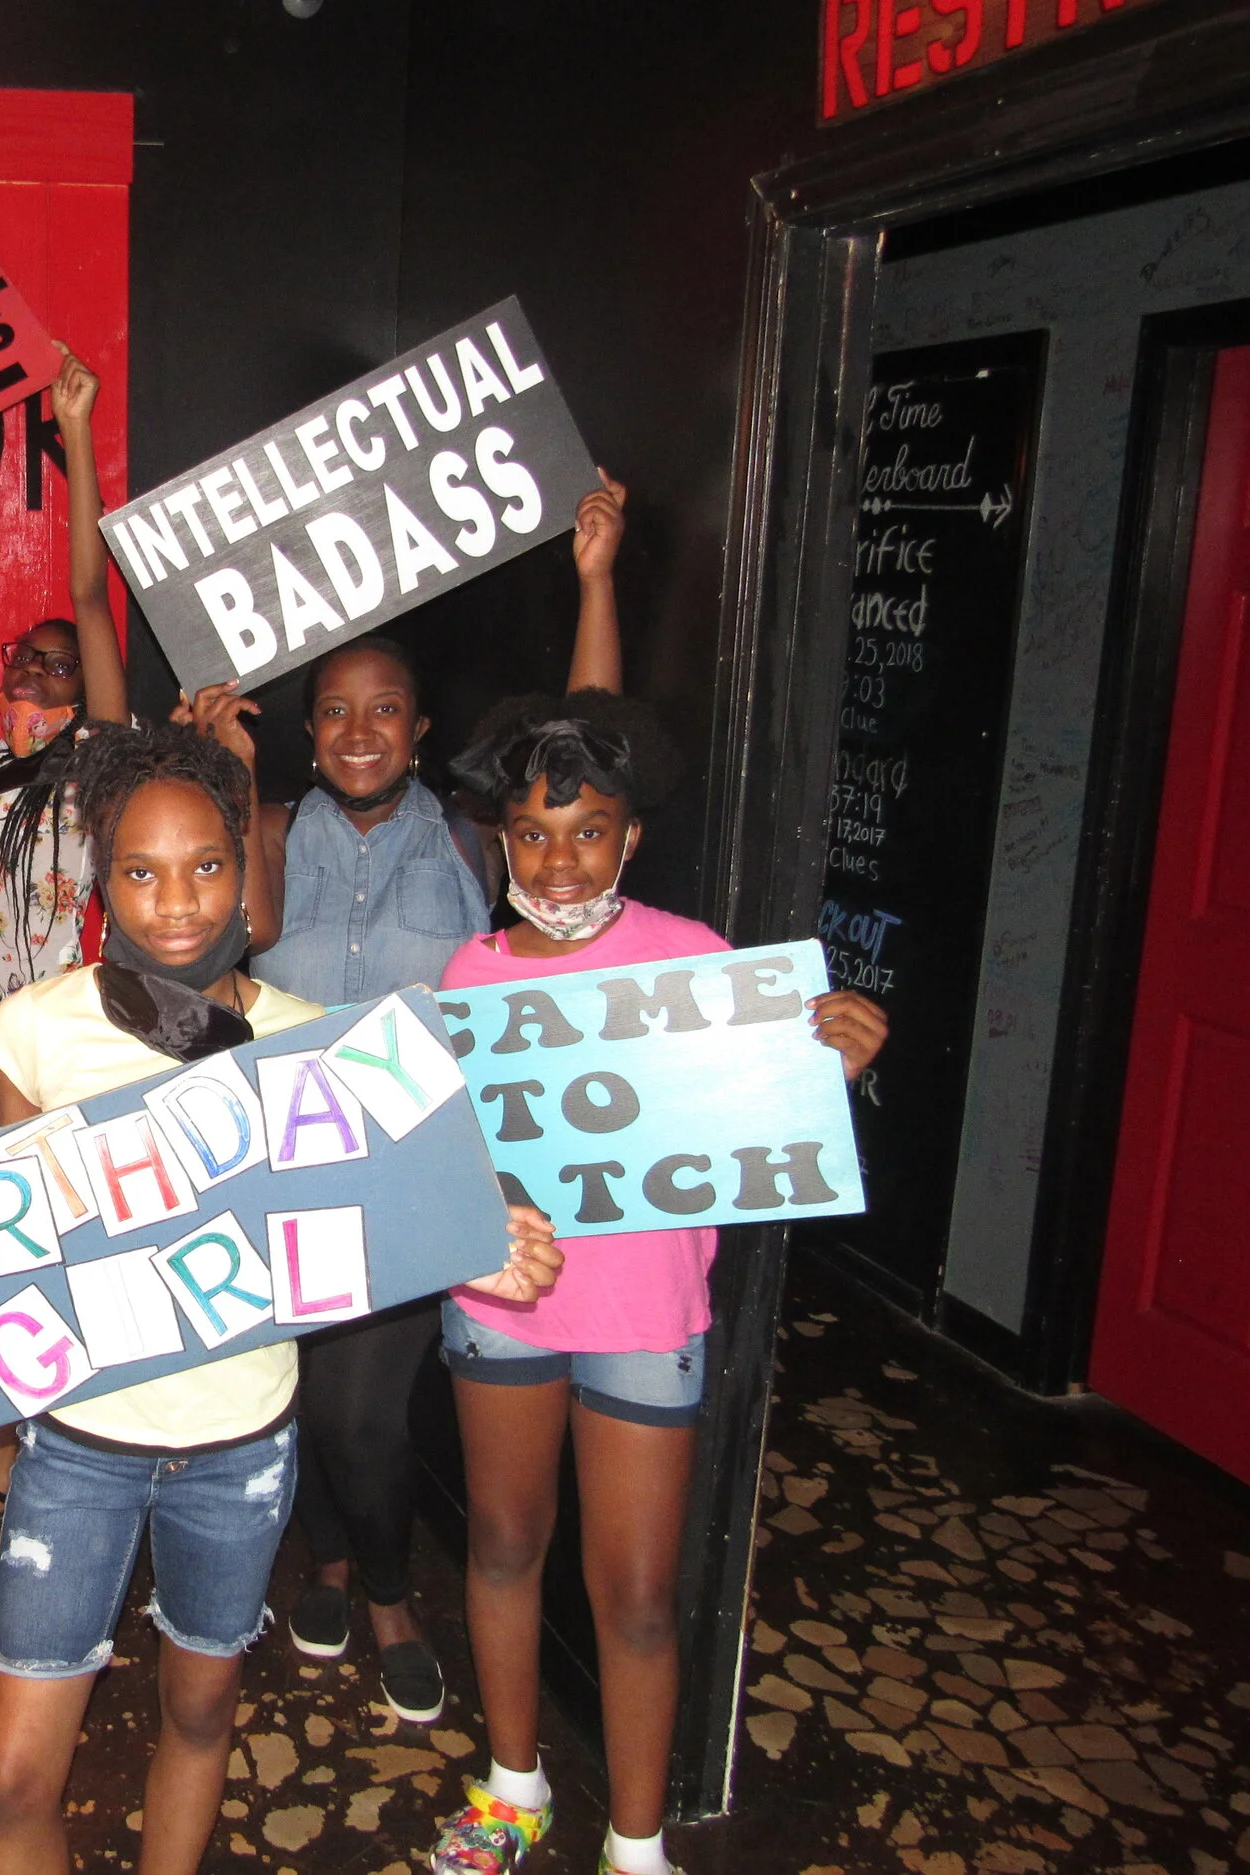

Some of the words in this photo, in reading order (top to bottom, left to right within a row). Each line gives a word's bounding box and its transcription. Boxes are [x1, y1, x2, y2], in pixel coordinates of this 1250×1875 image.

[879, 381, 942, 433] Time
[113, 322, 544, 589] INTELLECTUAL
[862, 435, 976, 493] erboard
[194, 426, 542, 676] BADASS
[854, 525, 937, 577] rifice
[851, 584, 929, 637] anced
[480, 1071, 640, 1142] TO
